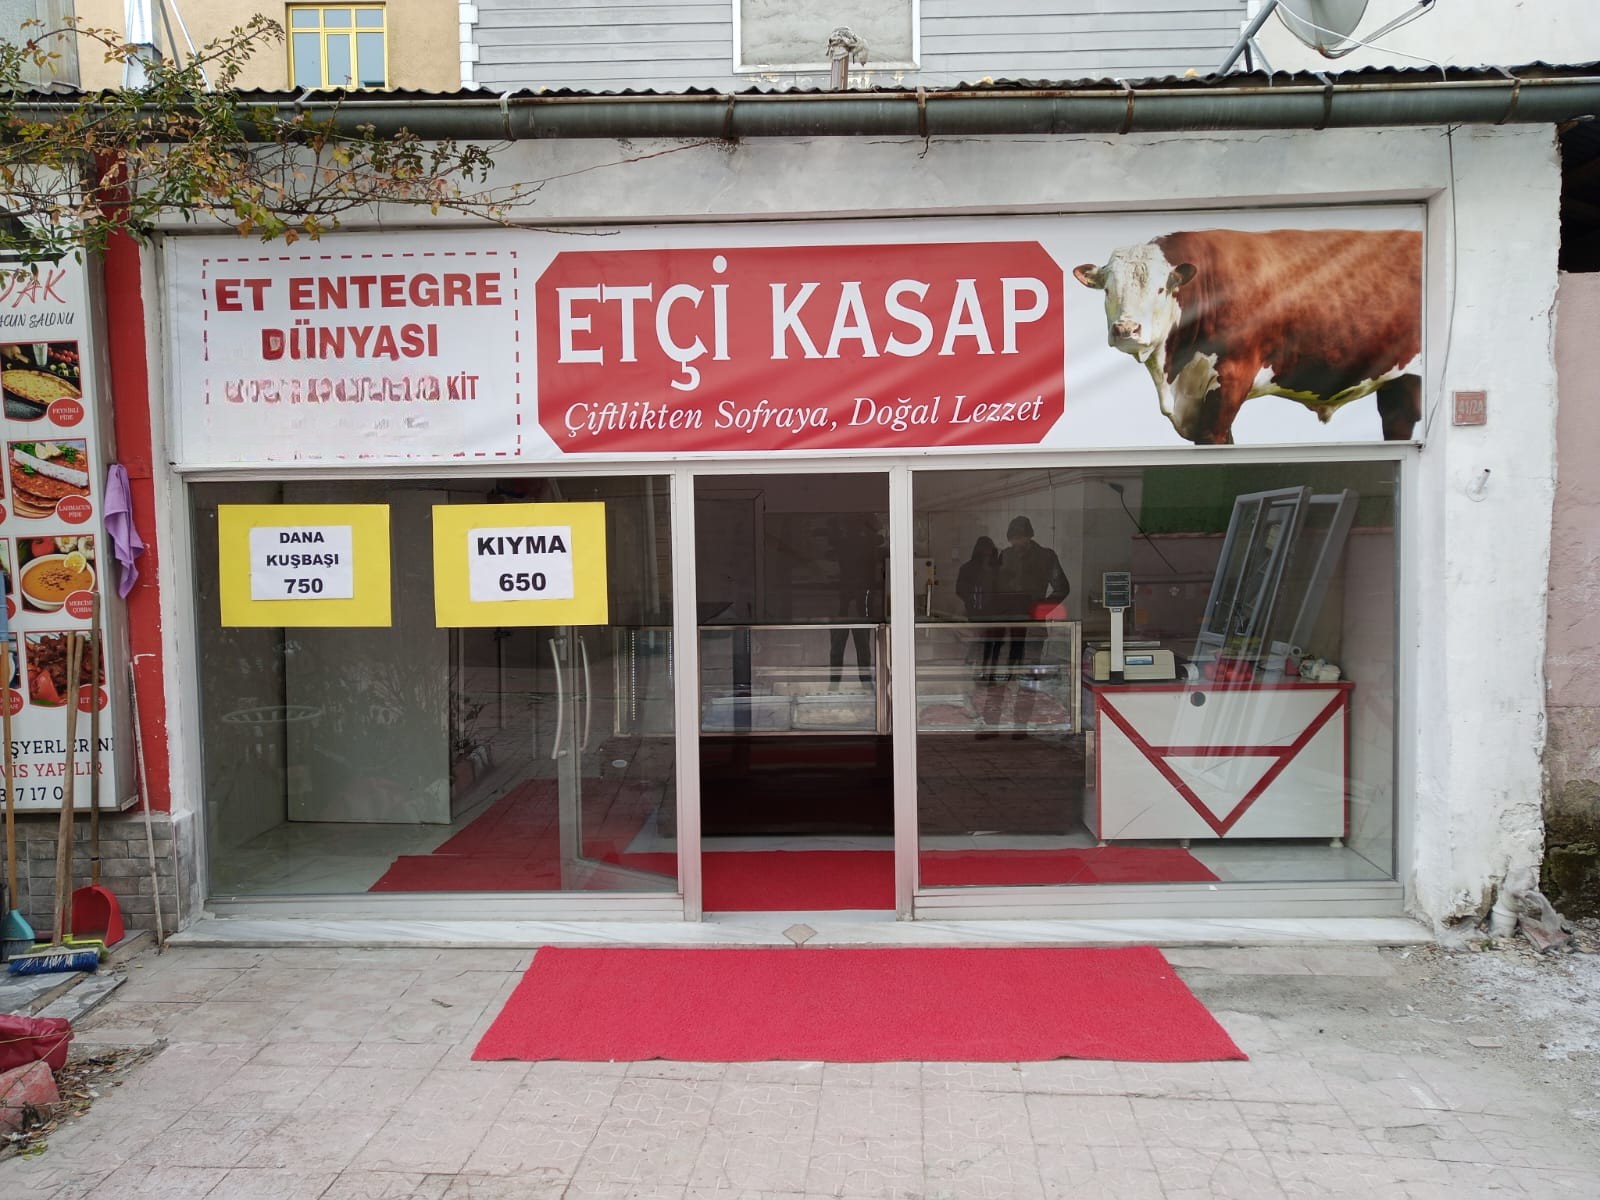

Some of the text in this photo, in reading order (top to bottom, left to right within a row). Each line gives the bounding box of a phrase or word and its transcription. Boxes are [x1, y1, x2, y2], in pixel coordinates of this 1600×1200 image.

[215, 272, 502, 311] ET ENTEGRE
[29, 311, 75, 328] SALONU
[556, 255, 1049, 391] ETÇİ KASAP
[262, 318, 439, 360] DÜNYASI
[446, 371, 479, 401] KİT
[564, 394, 1044, 438] Çiftlikten Sofraya, Doğal Lezzet
[58, 504, 91, 512] LAHMACUN
[279, 531, 325, 544] DANA
[477, 535, 567, 556] KIYMA
[266, 553, 340, 569] KUŞBAŞI
[283, 578, 324, 594] 750
[498, 572, 547, 592] 650
[34, 762, 104, 777] YAPLIR
[30, 787, 46, 801] 17
